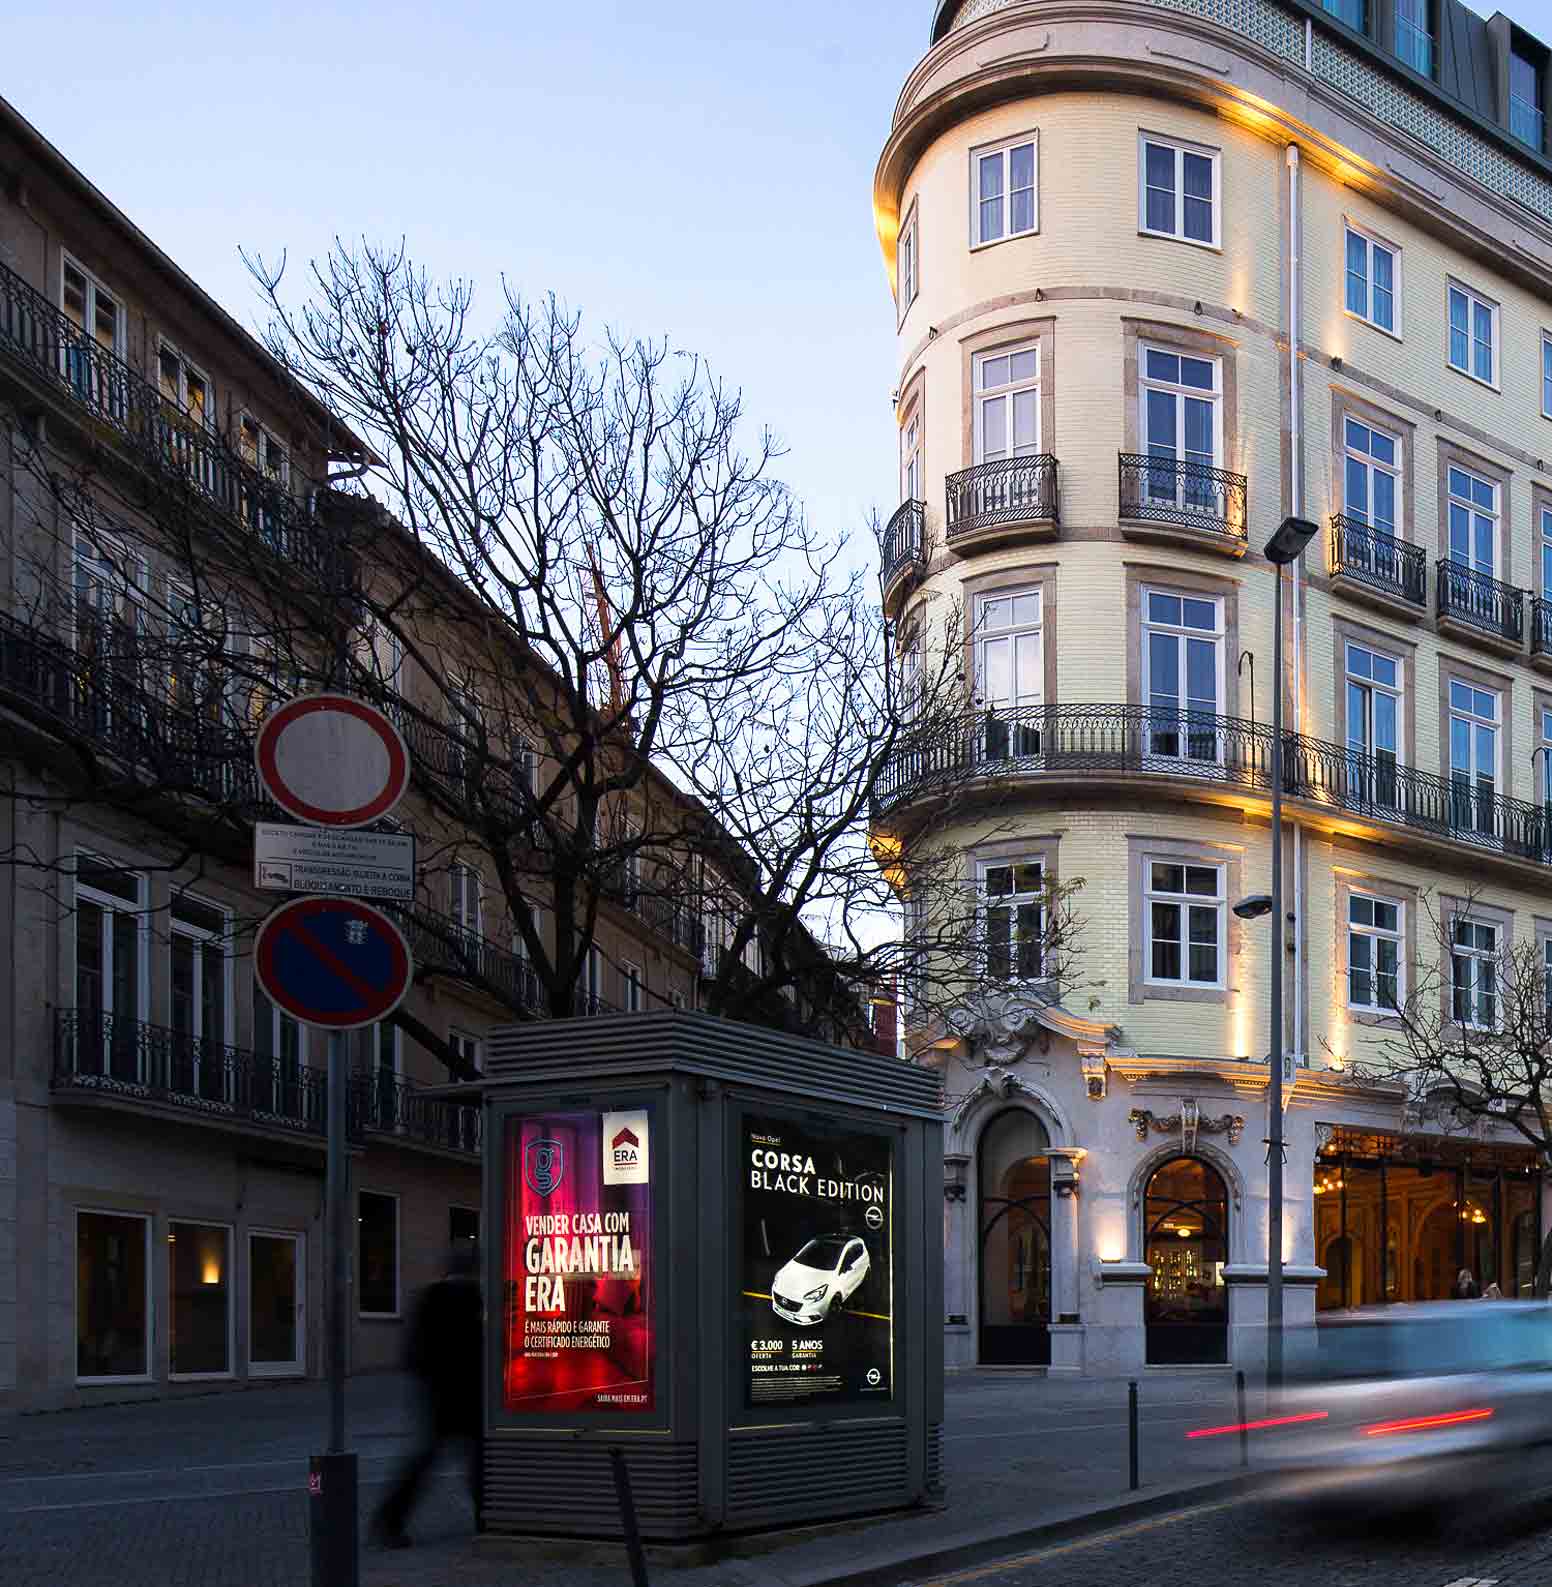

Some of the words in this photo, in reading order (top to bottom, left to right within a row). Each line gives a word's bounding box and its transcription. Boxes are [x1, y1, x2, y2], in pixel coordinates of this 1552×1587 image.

[614, 1150, 637, 1162] ERA
[751, 1148, 817, 1175] CORSA
[751, 1170, 811, 1195] BLACK
[817, 1178, 884, 1203] EDITION
[525, 1214, 569, 1235] VENDER
[572, 1213, 602, 1234] CASA
[604, 1212, 630, 1233] COM
[525, 1235, 634, 1274] GARANTIA
[525, 1275, 566, 1312] ERA
[530, 1321, 546, 1334] MAIS
[547, 1317, 572, 1333] RÁPIDO
[578, 1320, 611, 1333] GARANTE
[530, 1335, 571, 1348] CERTIFICADO
[571, 1333, 611, 1349] ENERGÉTICO
[759, 1340, 783, 1350] 3.000
[799, 1340, 823, 1350] ANOS
